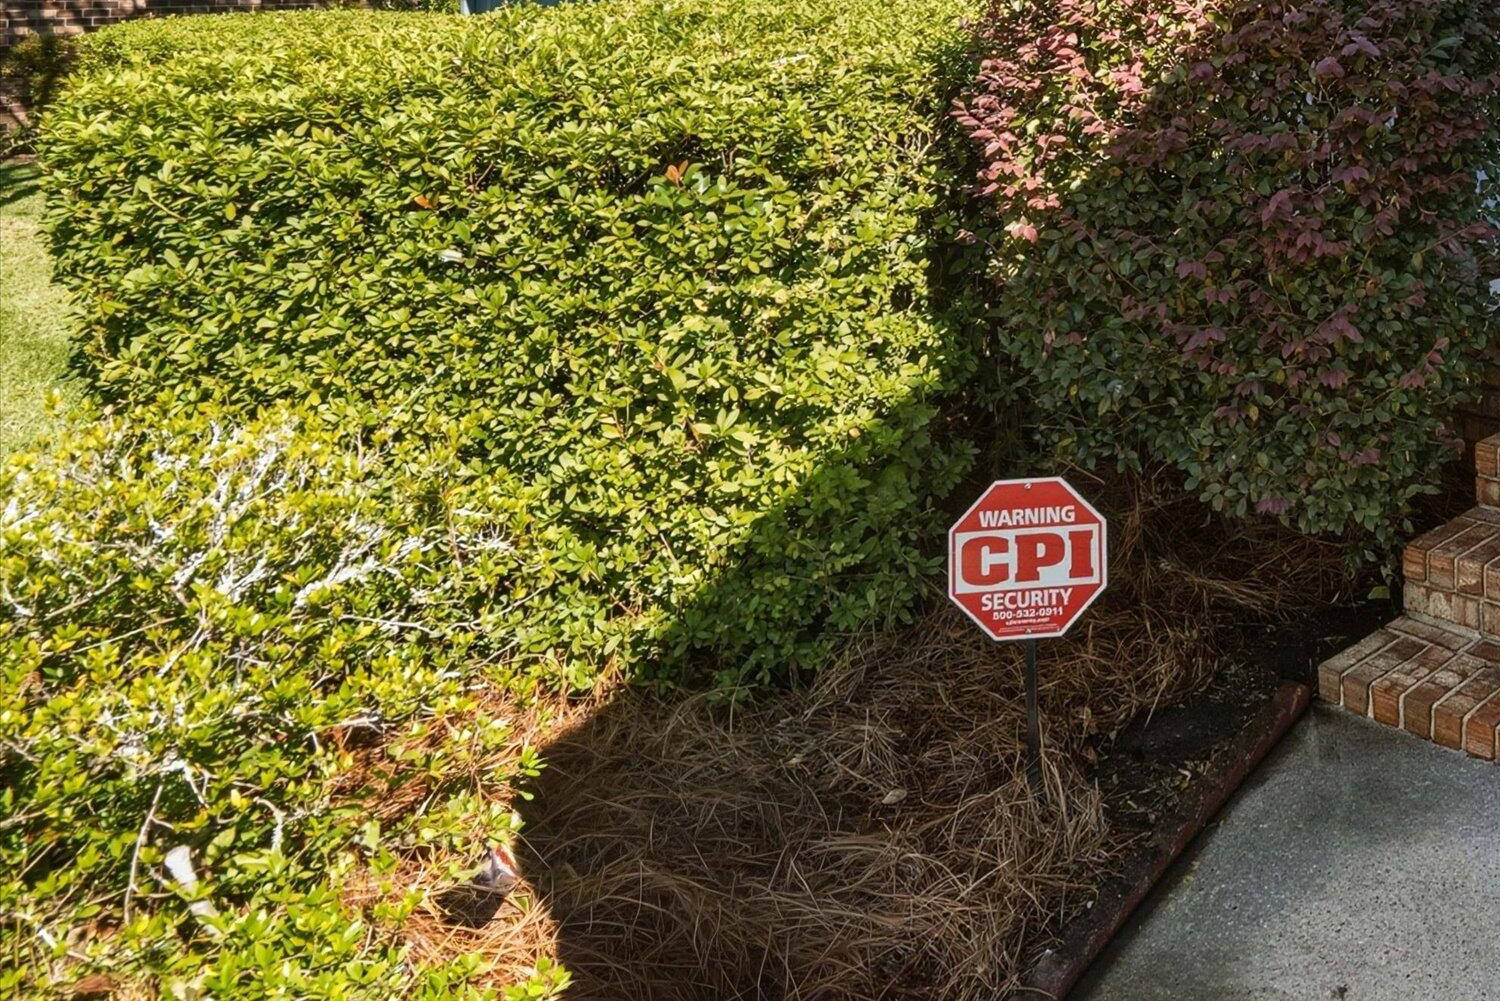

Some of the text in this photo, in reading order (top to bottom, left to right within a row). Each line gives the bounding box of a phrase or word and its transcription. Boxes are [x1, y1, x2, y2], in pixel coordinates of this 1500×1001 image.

[978, 505, 1076, 528] WARNING
[961, 529, 1094, 586] CPI
[981, 587, 1073, 611] SECURITY
